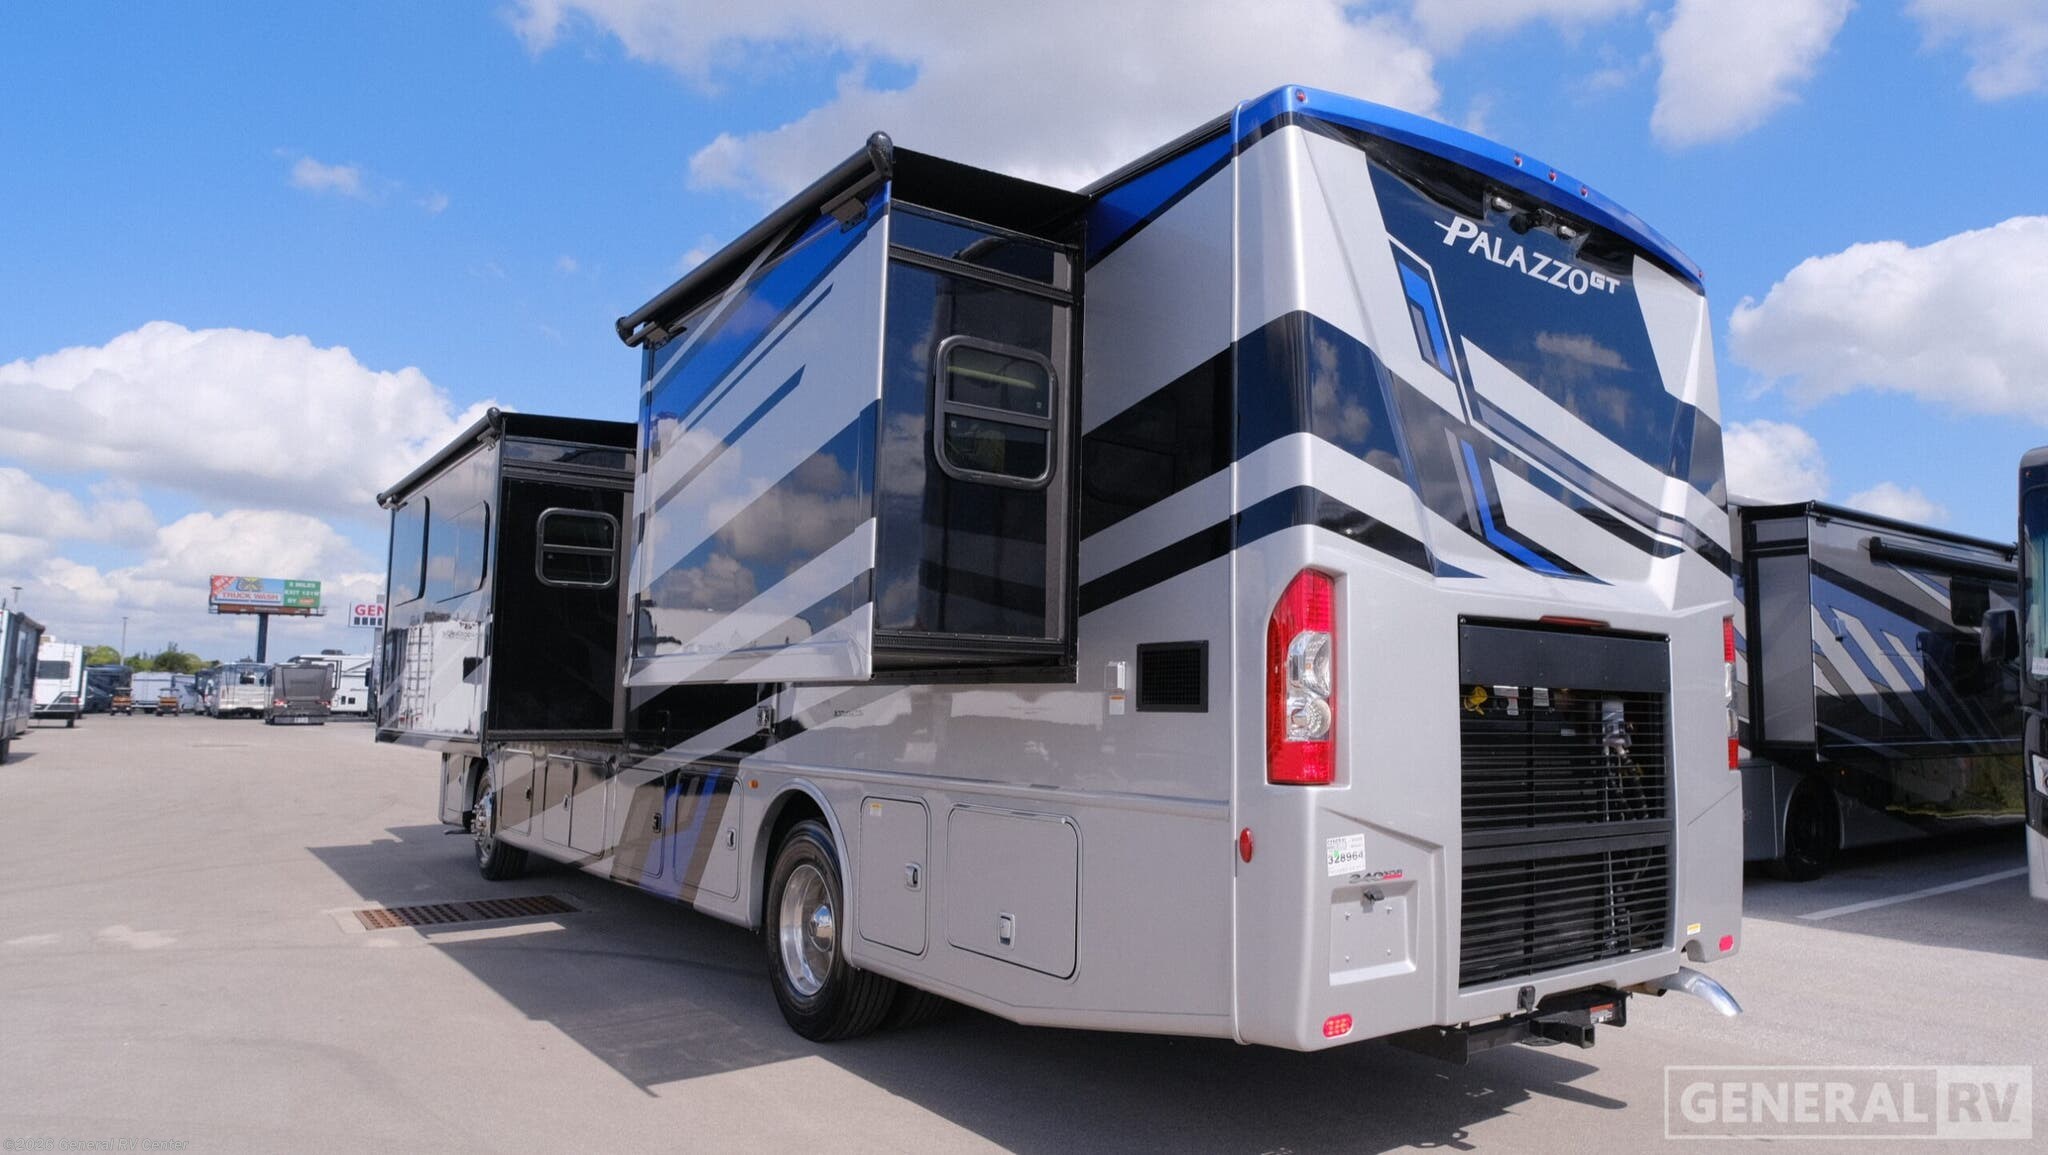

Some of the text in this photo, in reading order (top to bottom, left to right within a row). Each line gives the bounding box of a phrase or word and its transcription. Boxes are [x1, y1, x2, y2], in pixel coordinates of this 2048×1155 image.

[1434, 216, 1621, 295] PALAZZO GT
[223, 591, 279, 600] TRUCK WASH
